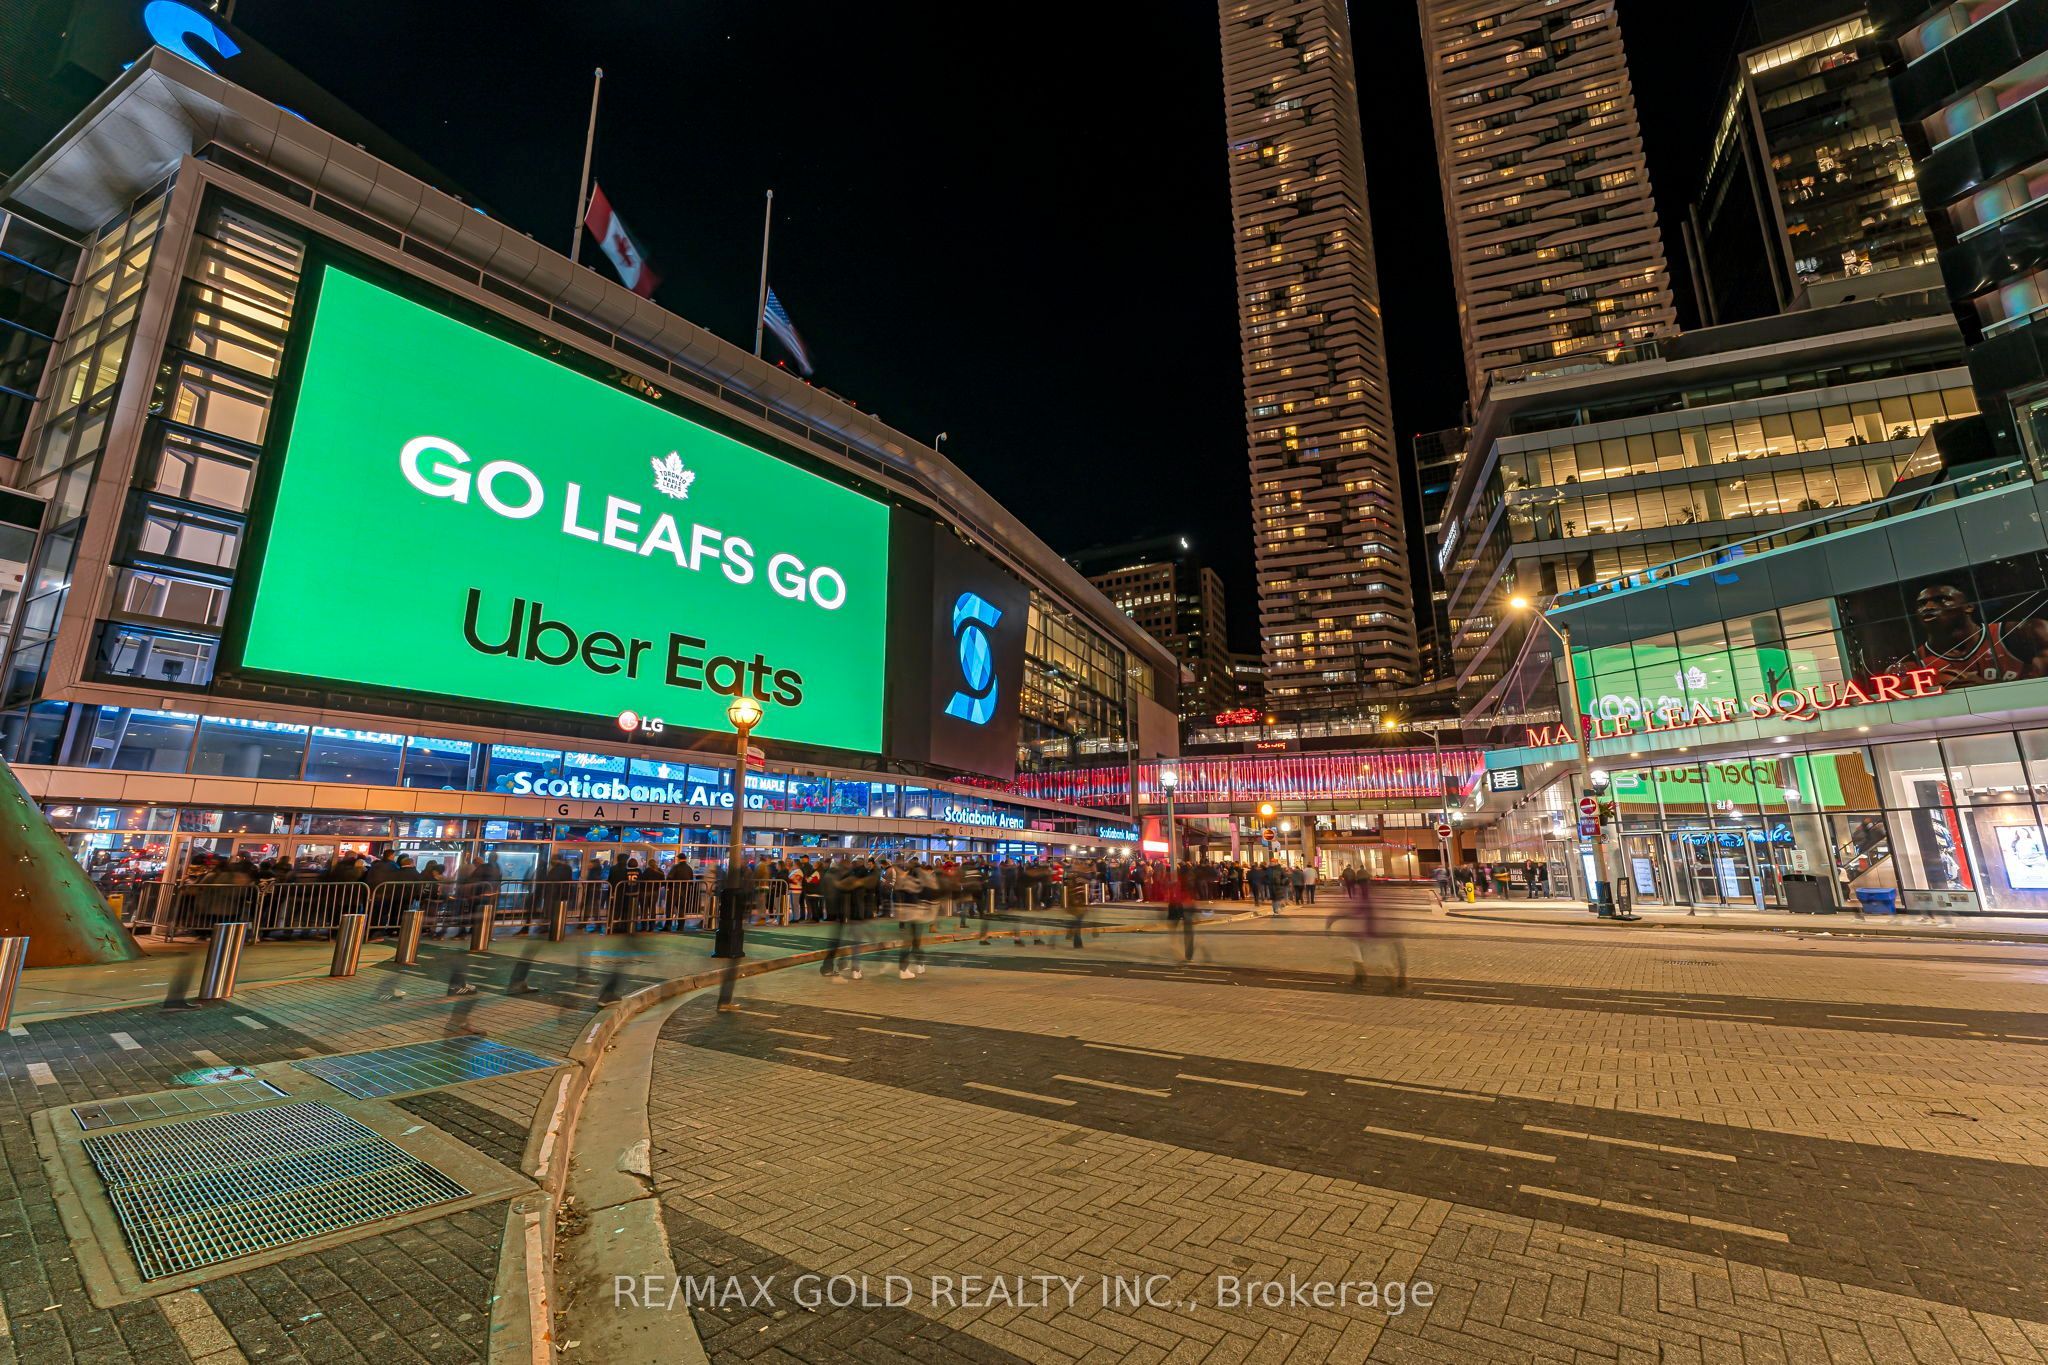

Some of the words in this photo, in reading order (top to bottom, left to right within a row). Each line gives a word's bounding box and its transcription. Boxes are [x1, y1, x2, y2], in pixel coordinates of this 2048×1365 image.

[659, 470, 687, 485] TORONTO
[662, 481, 682, 492] LEAFS
[663, 476, 682, 487] MAPLE
[399, 435, 545, 520] GO
[562, 482, 755, 586] LEAFS
[767, 553, 847, 611] GO
[463, 587, 653, 679] Uber
[665, 632, 804, 708] Eats
[1525, 713, 1635, 749] MALE
[1642, 697, 1739, 733] LEAF
[1750, 667, 1944, 722] SQUARE
[640, 715, 664, 733] LG
[512, 771, 683, 806] Scotiabank
[688, 785, 763, 810] Area
[557, 803, 671, 822] GATE
[692, 811, 701, 822] 6
[944, 806, 998, 827] Scotiabank
[999, 813, 1024, 830] Arena
[1099, 826, 1126, 840] Scotiabank
[1125, 830, 1139, 842] Arena
